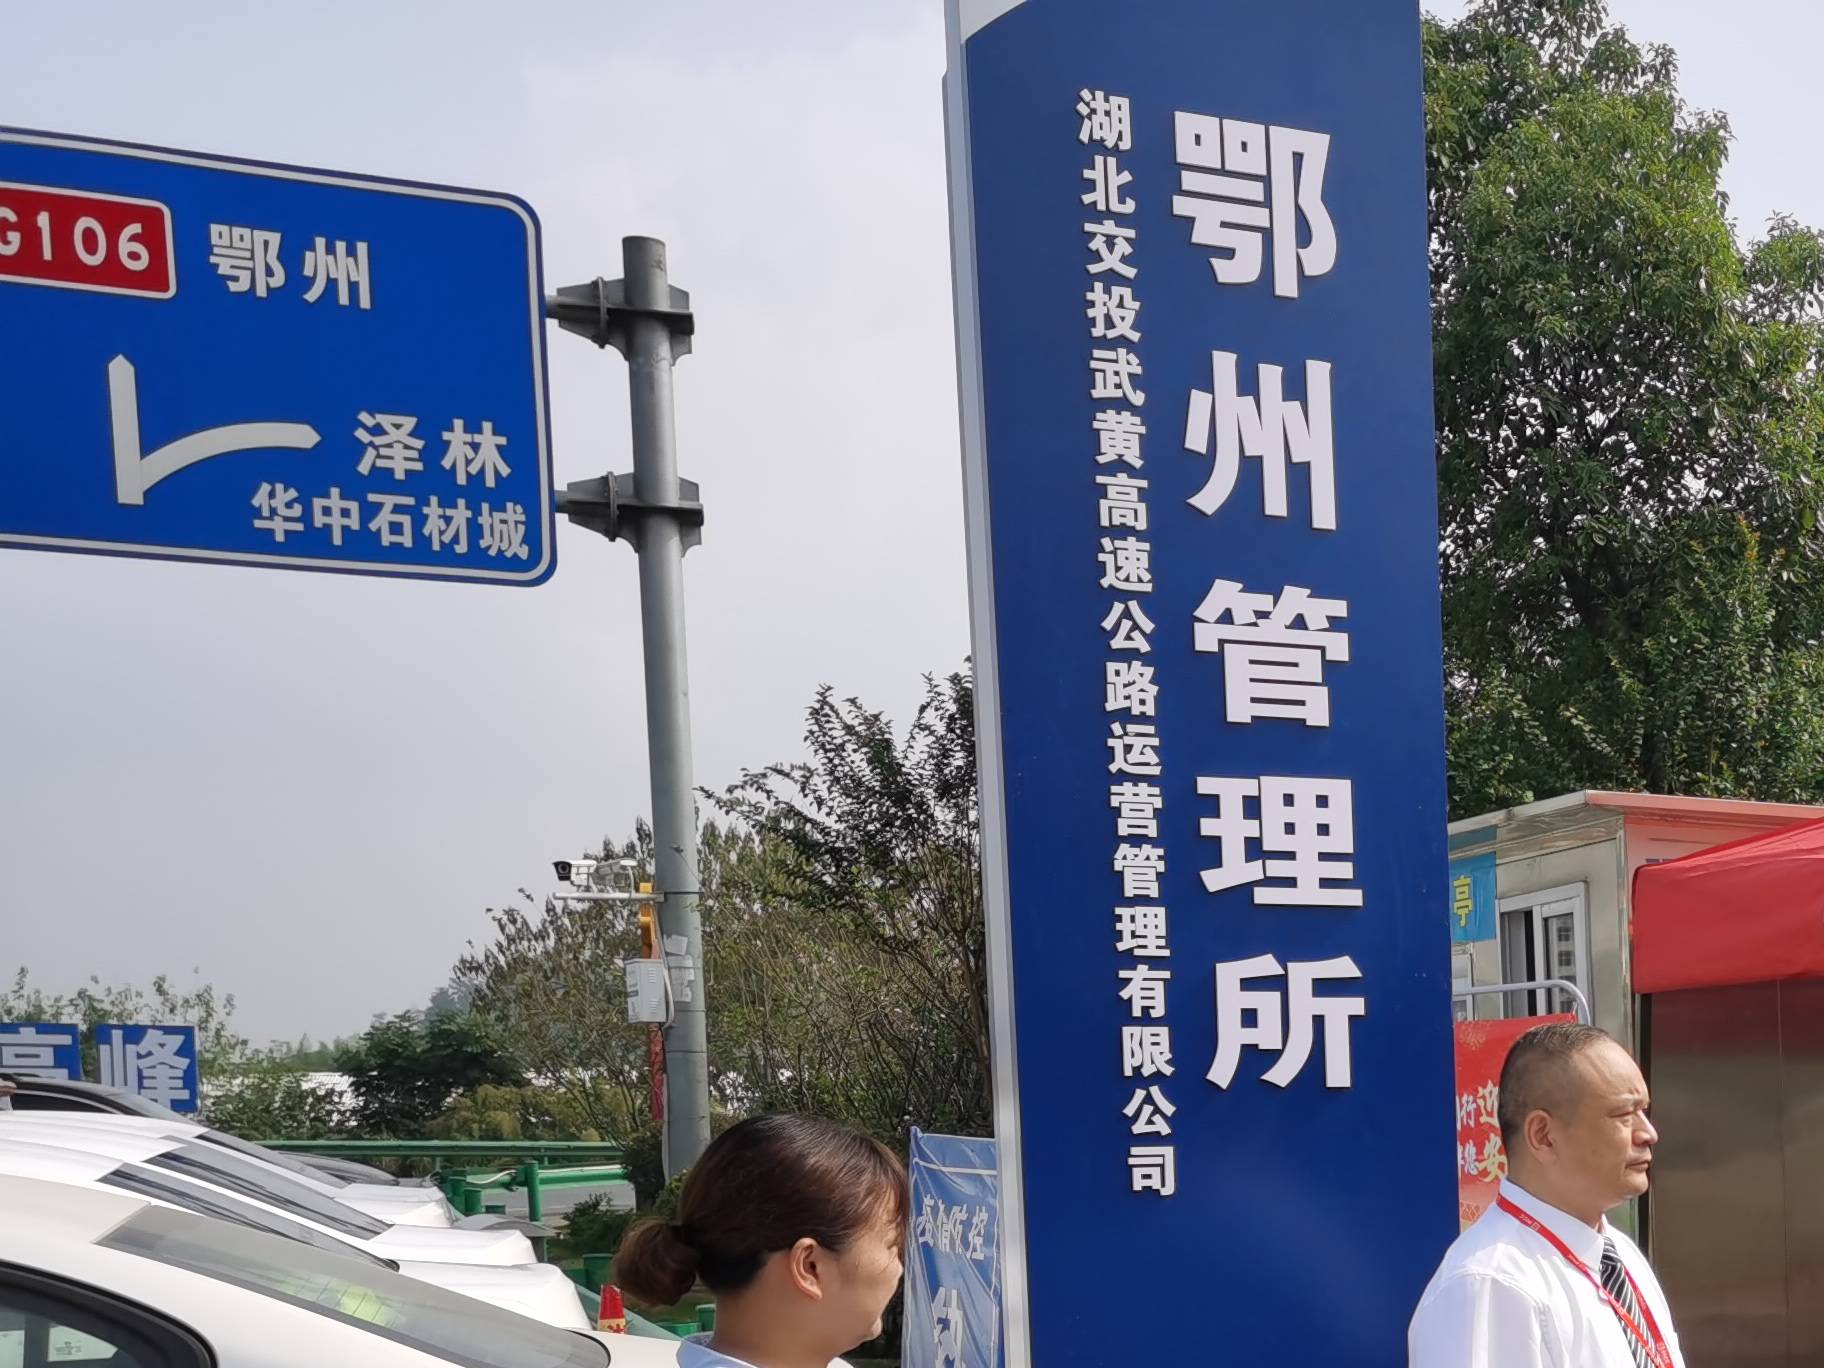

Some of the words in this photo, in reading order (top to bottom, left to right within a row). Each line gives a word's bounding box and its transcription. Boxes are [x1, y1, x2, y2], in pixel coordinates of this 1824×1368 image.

[0, 209, 150, 271] G106
[209, 223, 371, 310] 鄂州
[353, 411, 512, 488] 泽林
[250, 482, 529, 561] 华中石材城
[1172, 110, 1365, 1090] 鄂州管理所
[1076, 89, 1176, 1196] 湖北交投武黄高速公路运营管理有限公司
[1453, 874, 1473, 927] 亭
